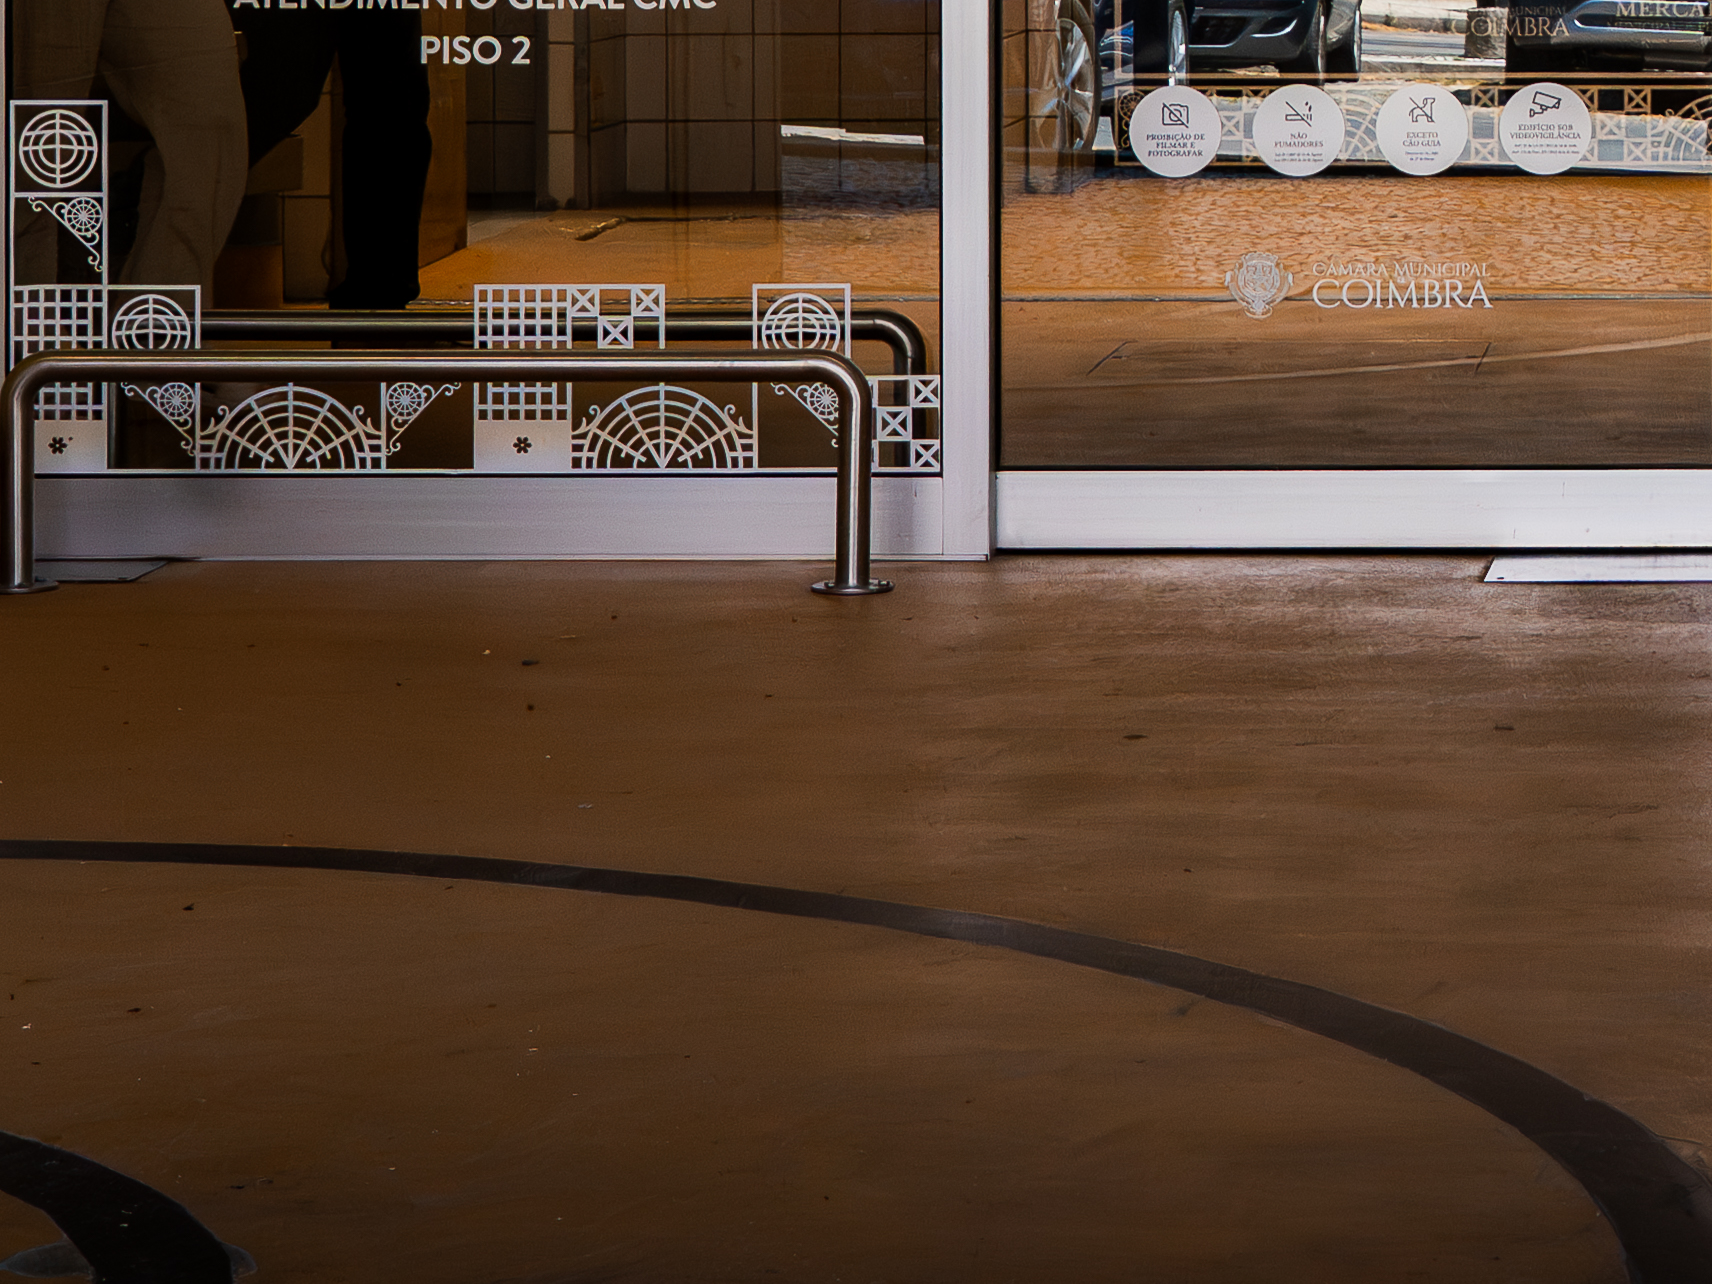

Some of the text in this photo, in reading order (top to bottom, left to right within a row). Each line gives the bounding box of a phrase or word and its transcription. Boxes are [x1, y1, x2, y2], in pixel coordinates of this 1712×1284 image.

[1450, 16, 1570, 37] COIMBRA
[420, 35, 531, 65] PISO 2
[1392, 259, 1491, 278] MUNICIPAL
[1312, 278, 1494, 309] COIMBRA
